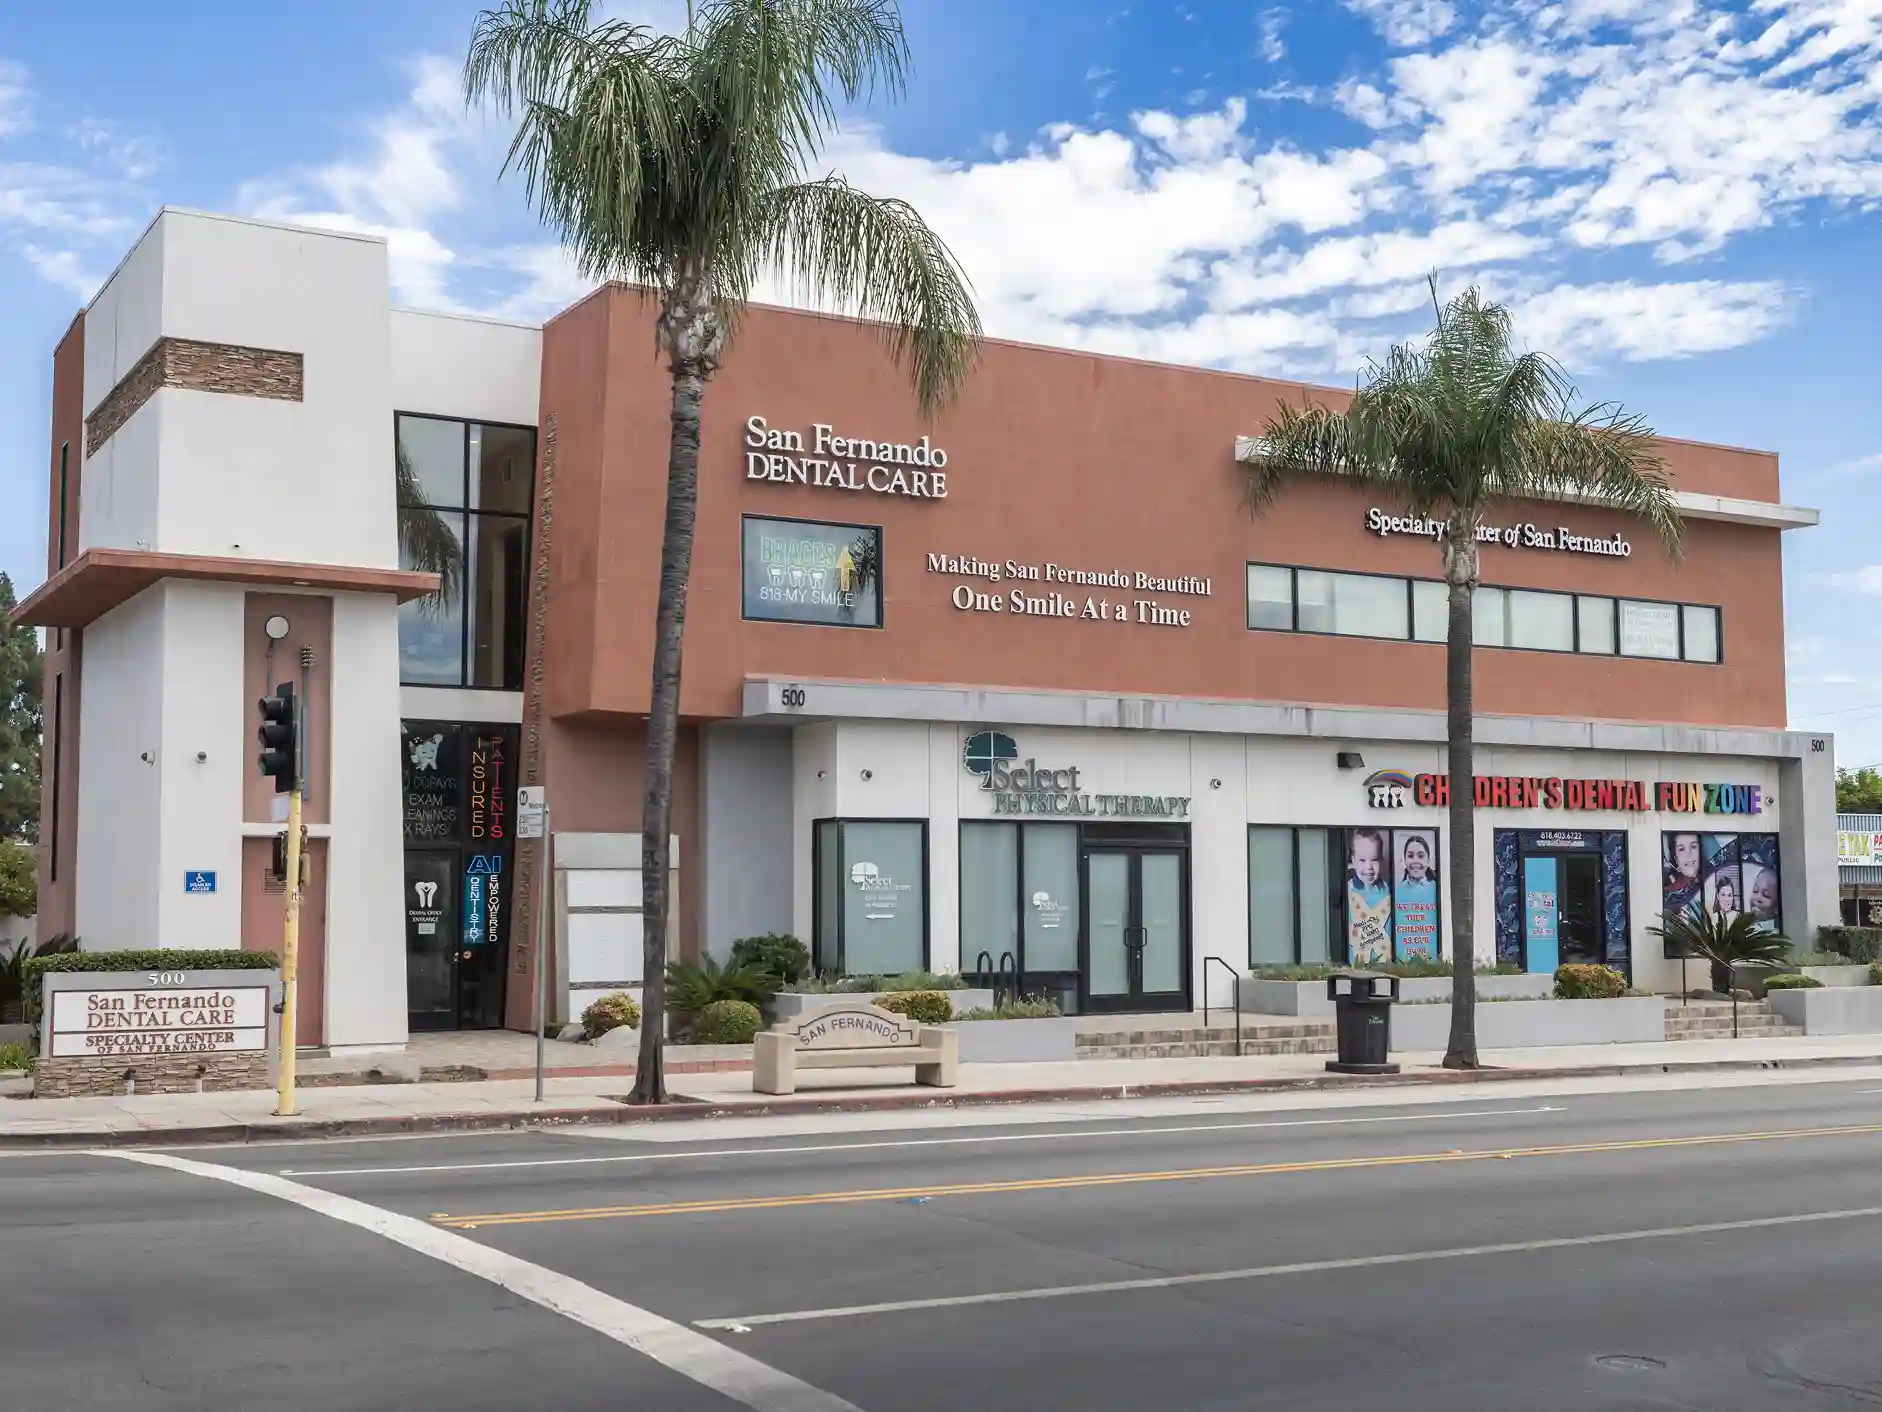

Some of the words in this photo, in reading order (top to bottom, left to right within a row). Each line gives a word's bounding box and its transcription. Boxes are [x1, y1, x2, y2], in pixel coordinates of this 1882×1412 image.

[747, 416, 804, 452] San
[812, 423, 948, 468] Fernando
[746, 452, 865, 490] DENTAL
[867, 466, 949, 498] CARE
[1368, 507, 1445, 541] Specialty
[1505, 524, 1522, 547] of
[1524, 524, 1556, 548] San
[1559, 527, 1632, 557] Fernando
[760, 535, 836, 569] BRACES
[927, 553, 1001, 582] Making
[1004, 559, 1039, 581] San
[1044, 563, 1130, 589] Fernando
[1134, 571, 1212, 596] Beautiful
[760, 586, 808, 603] 818-MY
[811, 590, 855, 607] SMILE
[952, 585, 1003, 612] One
[1010, 589, 1076, 617] Smile
[1080, 596, 1109, 621] At
[1115, 603, 1128, 621] a
[1133, 600, 1191, 627] Time
[782, 688, 806, 707] 500
[1811, 739, 1825, 752] 500
[993, 757, 1081, 792] Select
[409, 793, 443, 806] EXAM
[471, 737, 486, 838] INSURED
[490, 736, 505, 839] PATIENTS
[1414, 773, 1563, 810] CHDREN'S
[1564, 779, 1651, 811] DENTAL
[1655, 782, 1700, 814] FUN
[1704, 783, 1762, 814] ZONE
[993, 792, 1096, 816] PHYSICAL
[1096, 795, 1192, 817] THERAPY
[415, 823, 447, 836] RAYS
[1848, 833, 1869, 856] TAX
[467, 855, 502, 874] AI
[470, 876, 481, 942] DENTISTRY
[488, 874, 500, 942] EMPOWERED
[1396, 924, 1436, 933] CHILDREN
[1402, 936, 1412, 945] AS
[148, 972, 185, 986] 500
[87, 994, 125, 1011] San
[133, 992, 235, 1009] Fernando
[87, 1011, 173, 1029] DENTAL
[180, 1010, 235, 1026] CARE
[800, 1023, 827, 1045] SAN
[831, 1017, 900, 1043] FERNANDO
[85, 1033, 171, 1047] SPECIALTY
[174, 1031, 235, 1044] CENTER
[97, 1046, 111, 1054] OF
[119, 1045, 143, 1053] SAN
[149, 1043, 217, 1053] FERNANDO
